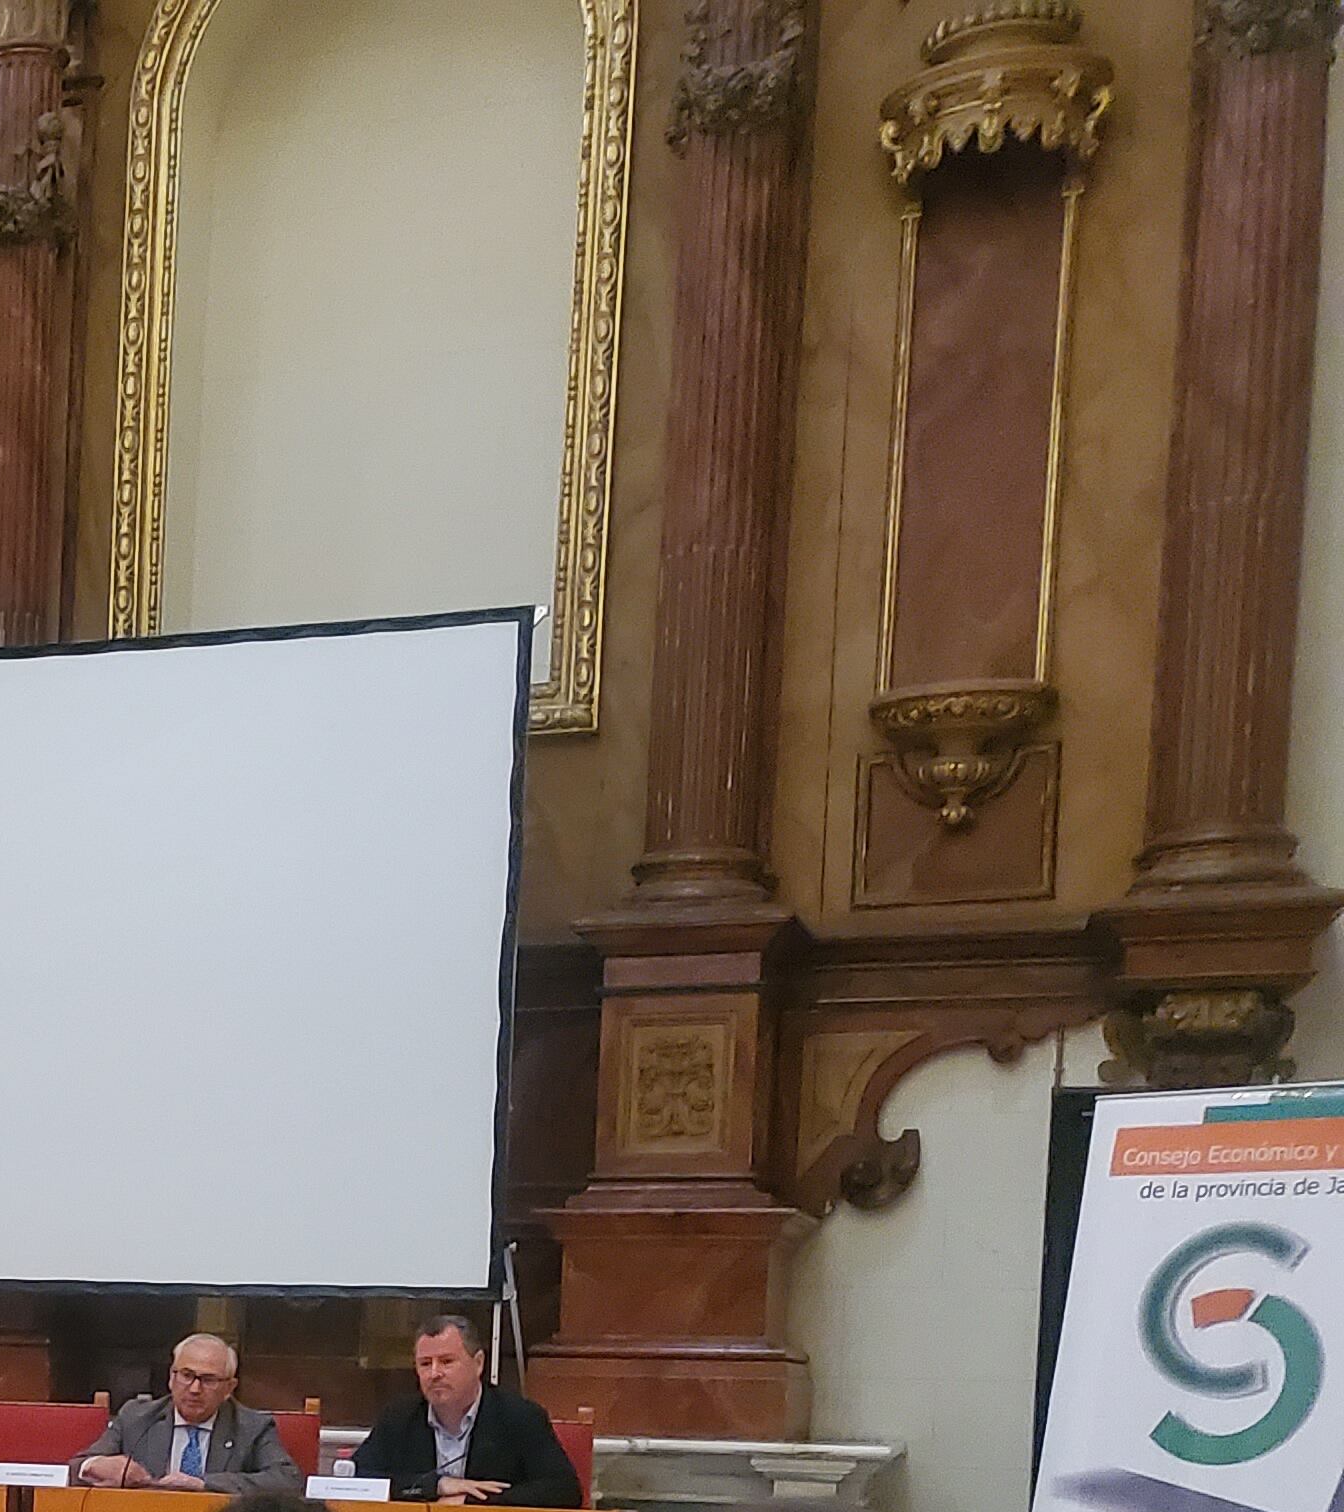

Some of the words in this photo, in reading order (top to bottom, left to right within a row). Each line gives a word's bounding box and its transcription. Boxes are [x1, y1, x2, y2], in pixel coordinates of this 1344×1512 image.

[1123, 1147, 1201, 1168] Consejo
[1208, 1142, 1318, 1164] Económico
[1325, 1144, 1338, 1162] y
[1139, 1181, 1165, 1199] de
[1171, 1180, 1188, 1198] la
[1195, 1178, 1285, 1202] provincia
[1293, 1177, 1319, 1195] de
